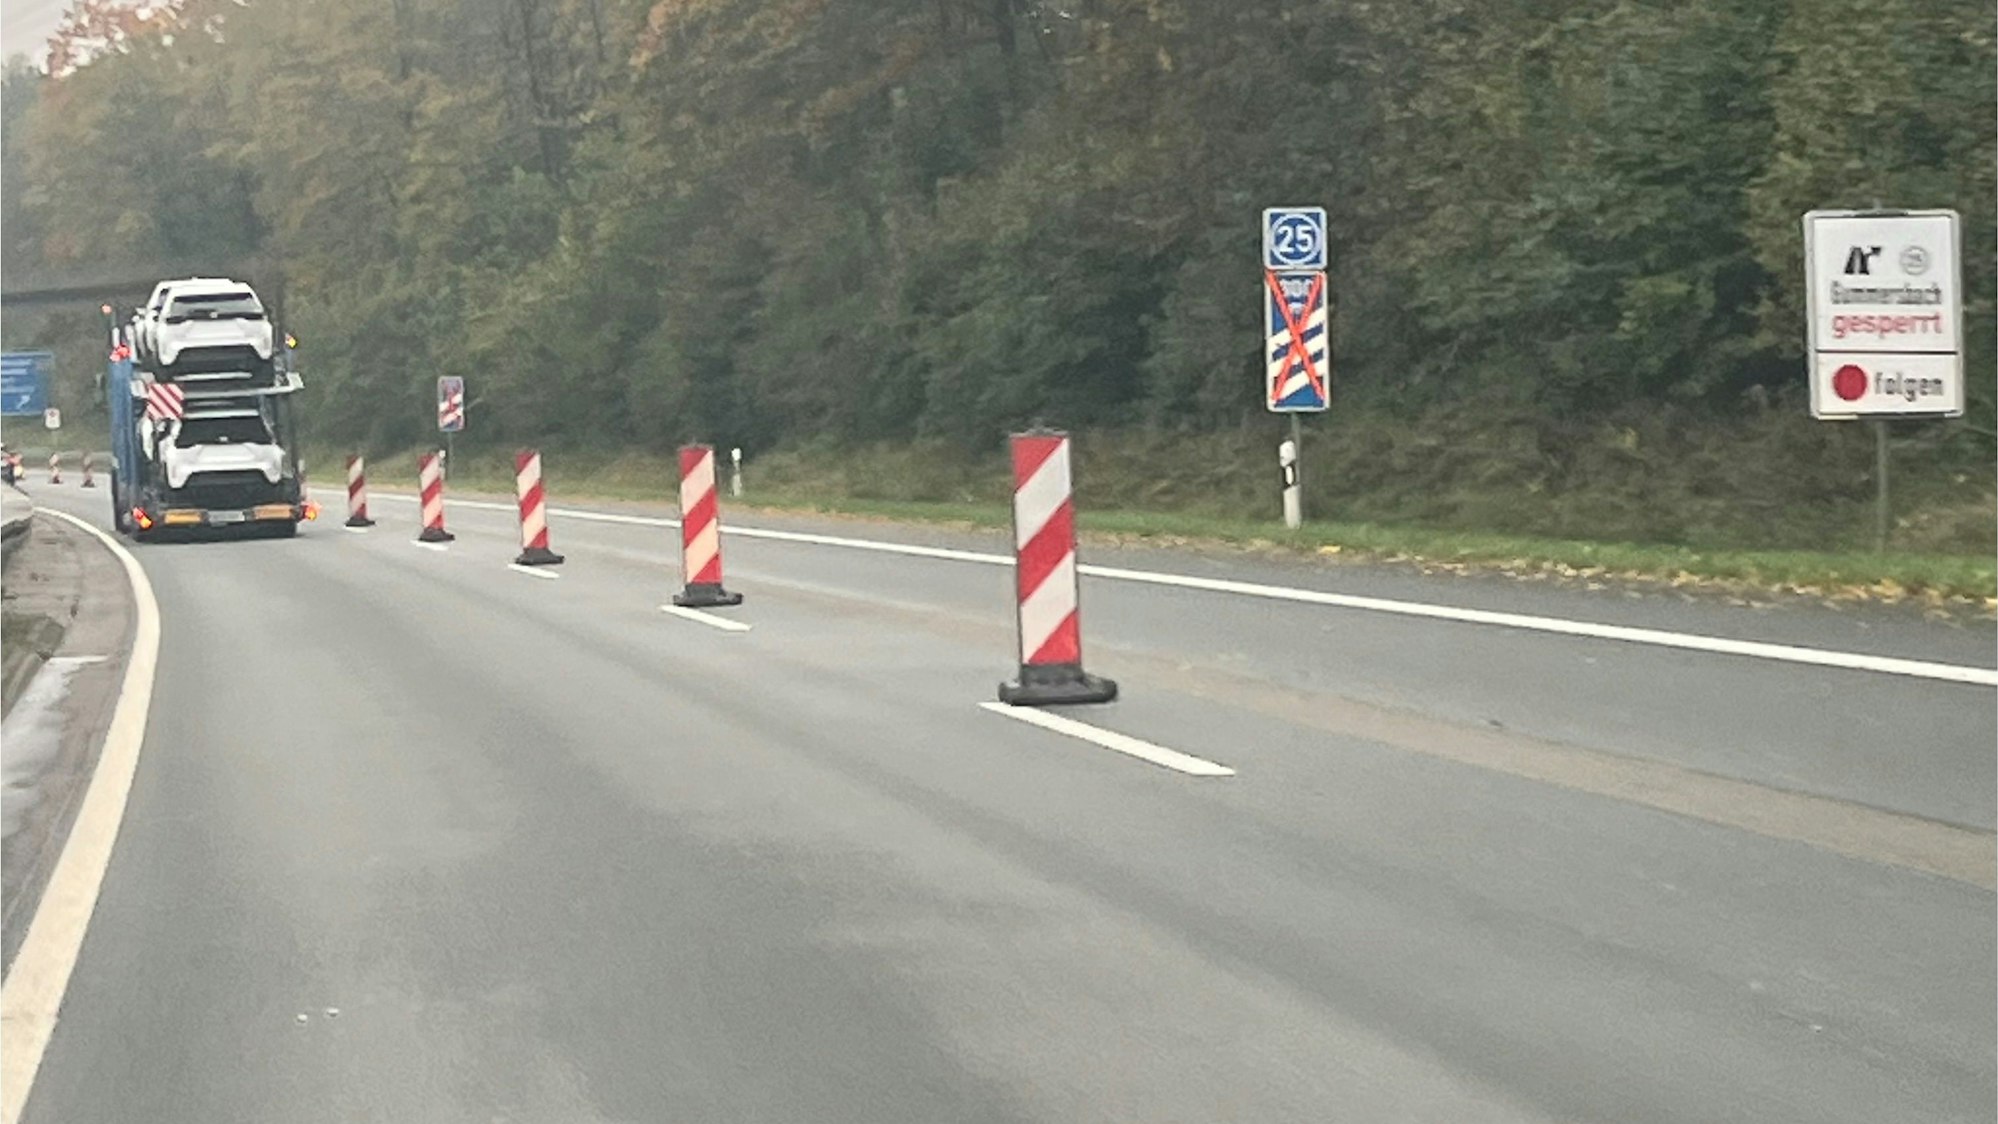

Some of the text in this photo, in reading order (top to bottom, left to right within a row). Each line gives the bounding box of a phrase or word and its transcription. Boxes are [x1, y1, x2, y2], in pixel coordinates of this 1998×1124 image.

[1278, 226, 1313, 253] 25
[1832, 312, 1943, 339] gesperrt
[1874, 371, 1944, 402] folgen
